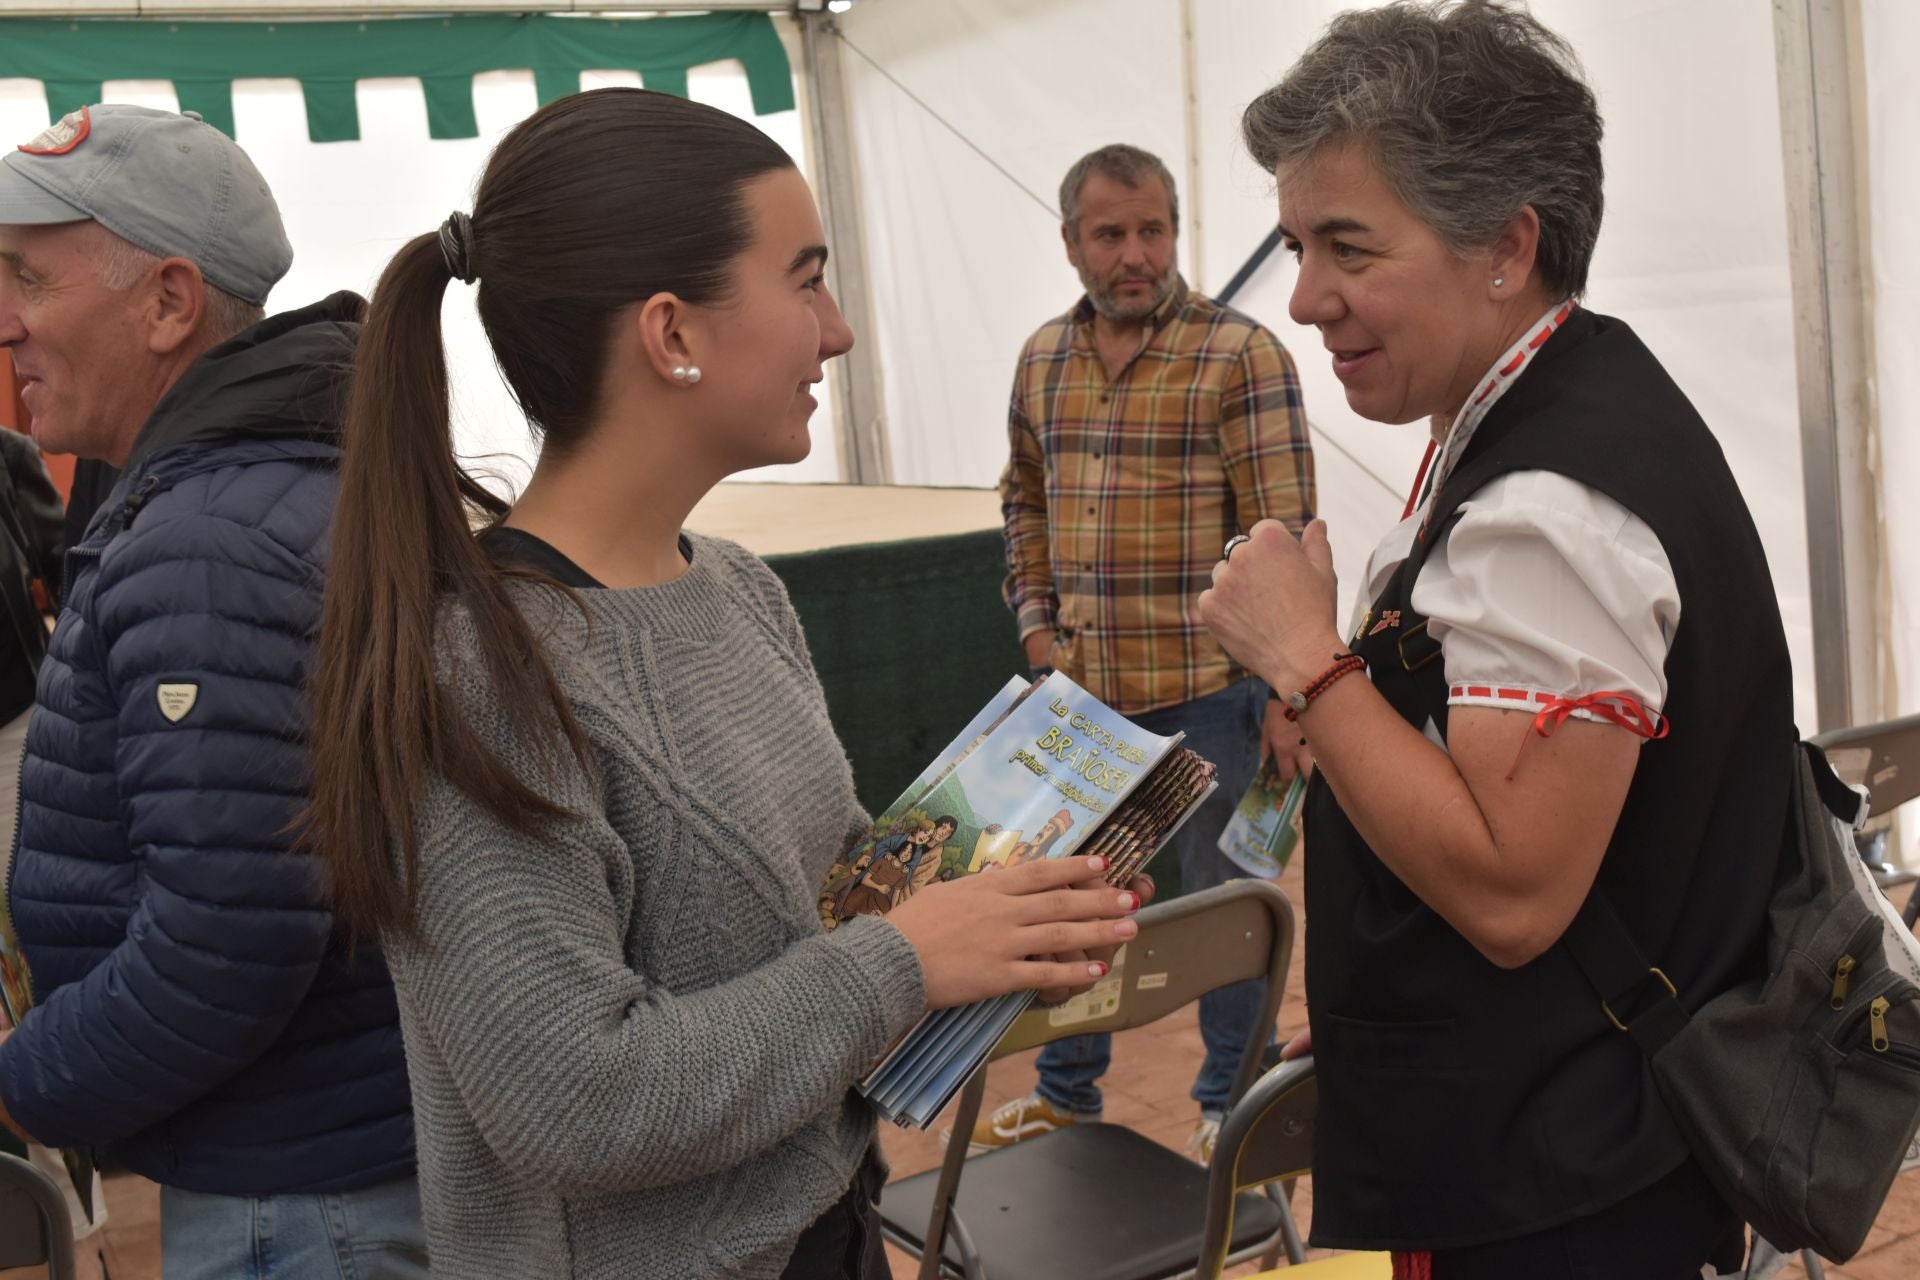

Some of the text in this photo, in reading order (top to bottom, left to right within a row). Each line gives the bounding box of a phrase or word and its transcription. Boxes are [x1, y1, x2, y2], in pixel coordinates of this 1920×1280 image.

[1049, 697, 1068, 717] La
[1070, 713, 1114, 750] CARTA
[1008, 748, 1048, 776] primer
